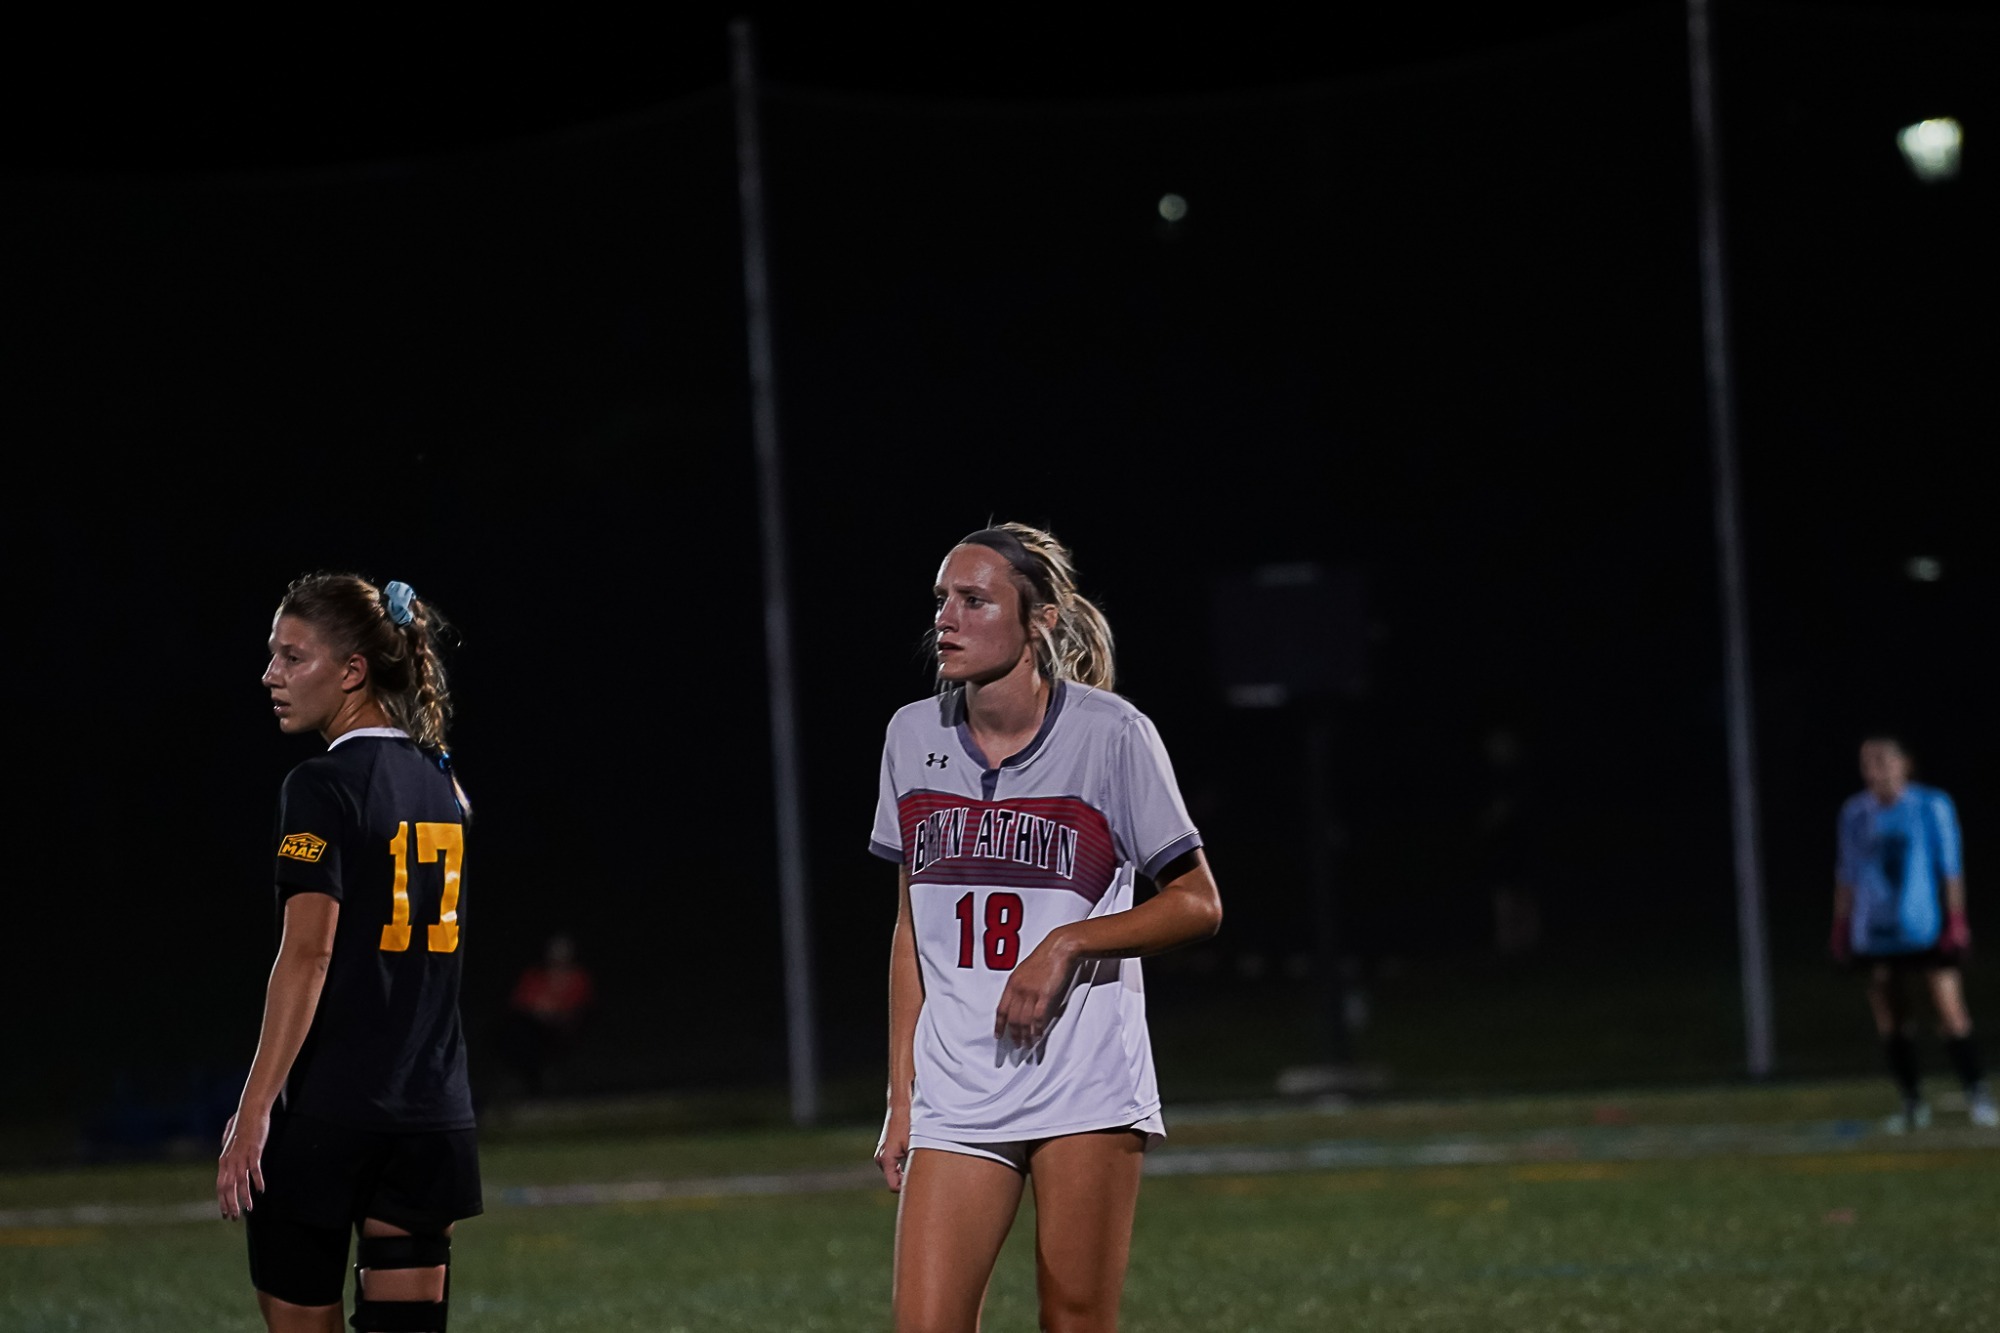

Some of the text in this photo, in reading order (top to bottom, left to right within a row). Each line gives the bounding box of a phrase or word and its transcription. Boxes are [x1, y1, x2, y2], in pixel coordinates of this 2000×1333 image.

[281, 843, 320, 859] MAC
[973, 808, 1078, 880] ATHYN
[379, 821, 464, 953] 17
[956, 891, 1023, 971] 18
